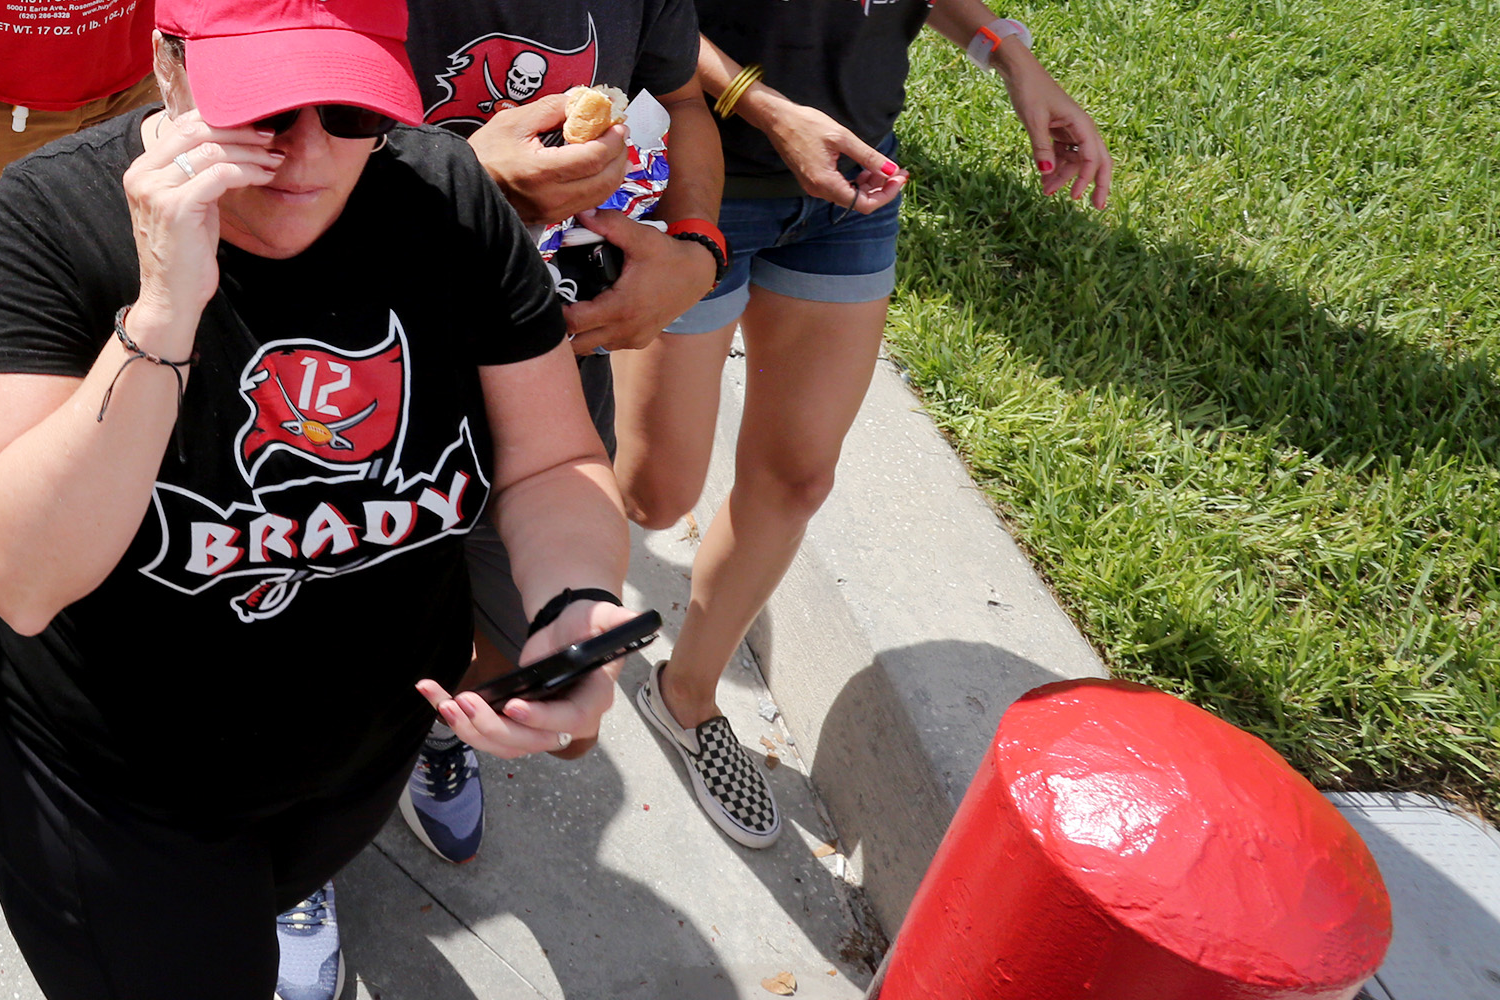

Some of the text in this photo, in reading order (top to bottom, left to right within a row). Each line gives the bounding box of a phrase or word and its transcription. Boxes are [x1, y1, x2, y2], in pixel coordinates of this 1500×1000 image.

[13, 24, 33, 34] WT.
[37, 26, 50, 35] 17
[53, 26, 73, 35] OZ.
[77, 24, 86, 35] (1
[89, 20, 101, 30] lb.
[299, 355, 351, 418] 12
[185, 470, 471, 577] BRADY
